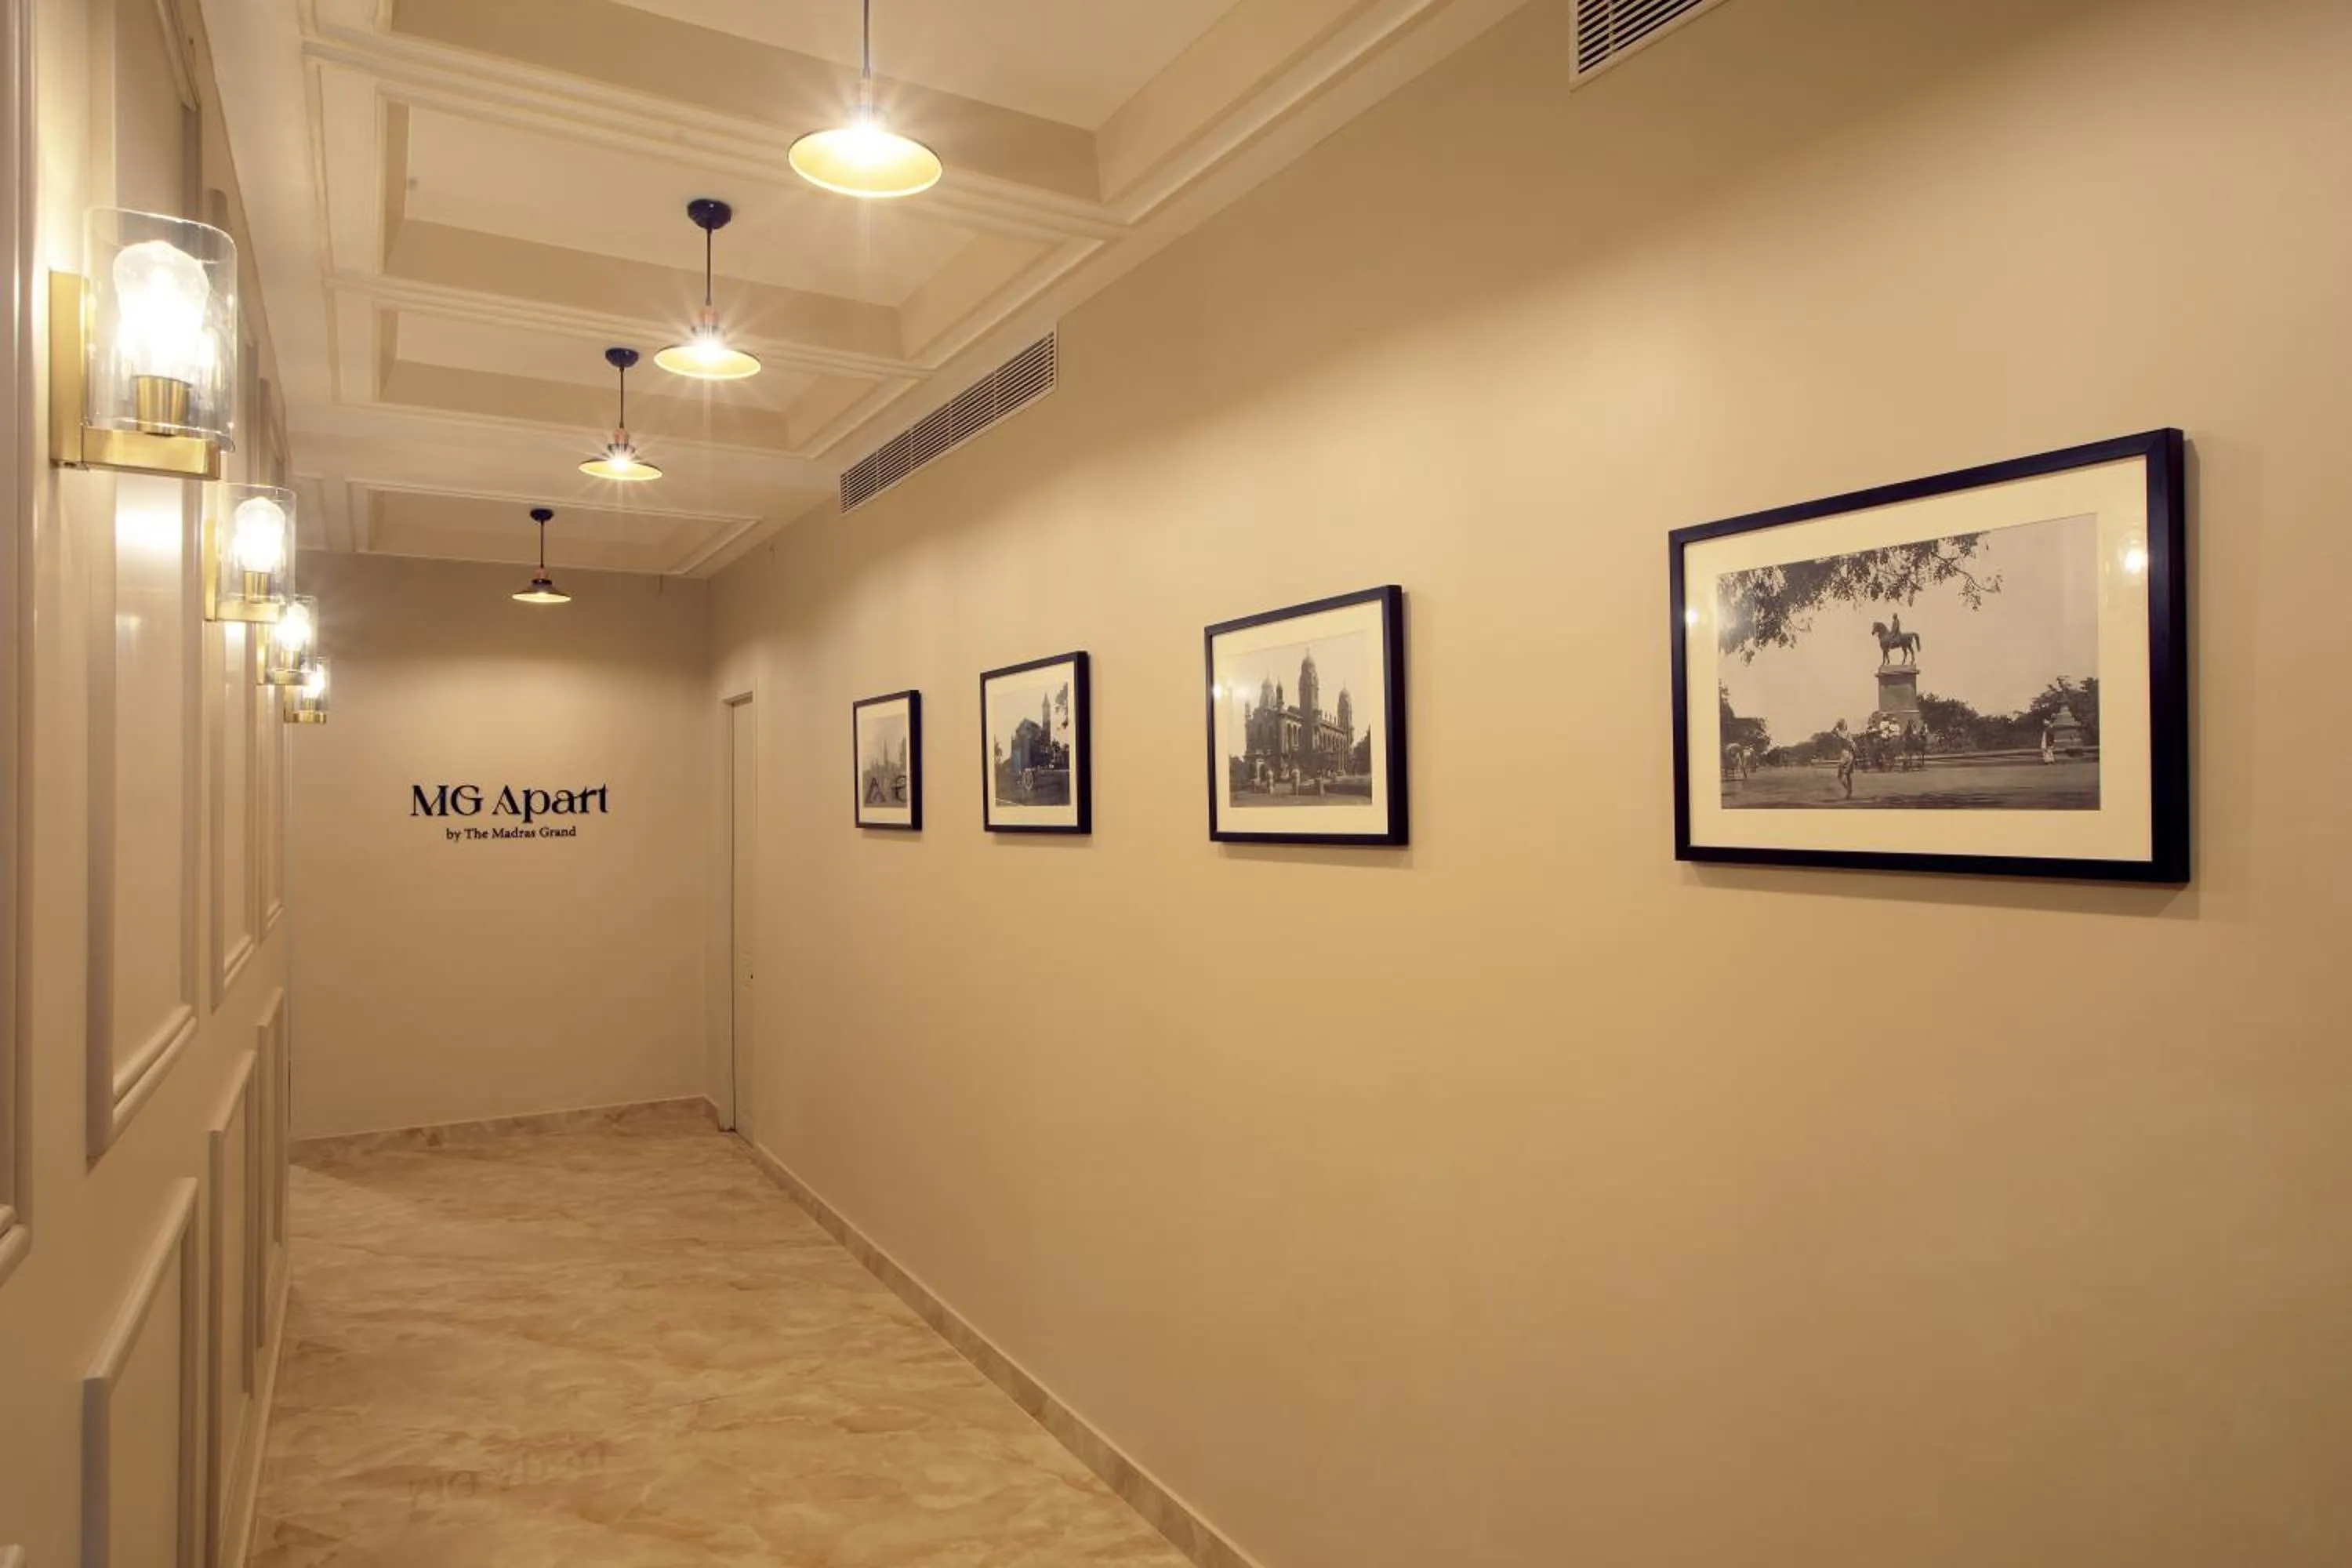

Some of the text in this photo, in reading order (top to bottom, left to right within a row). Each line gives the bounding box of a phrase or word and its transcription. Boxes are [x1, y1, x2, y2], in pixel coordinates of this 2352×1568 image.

[411, 783, 608, 823] MG Apart
[446, 826, 577, 842] by The Madras Grand
